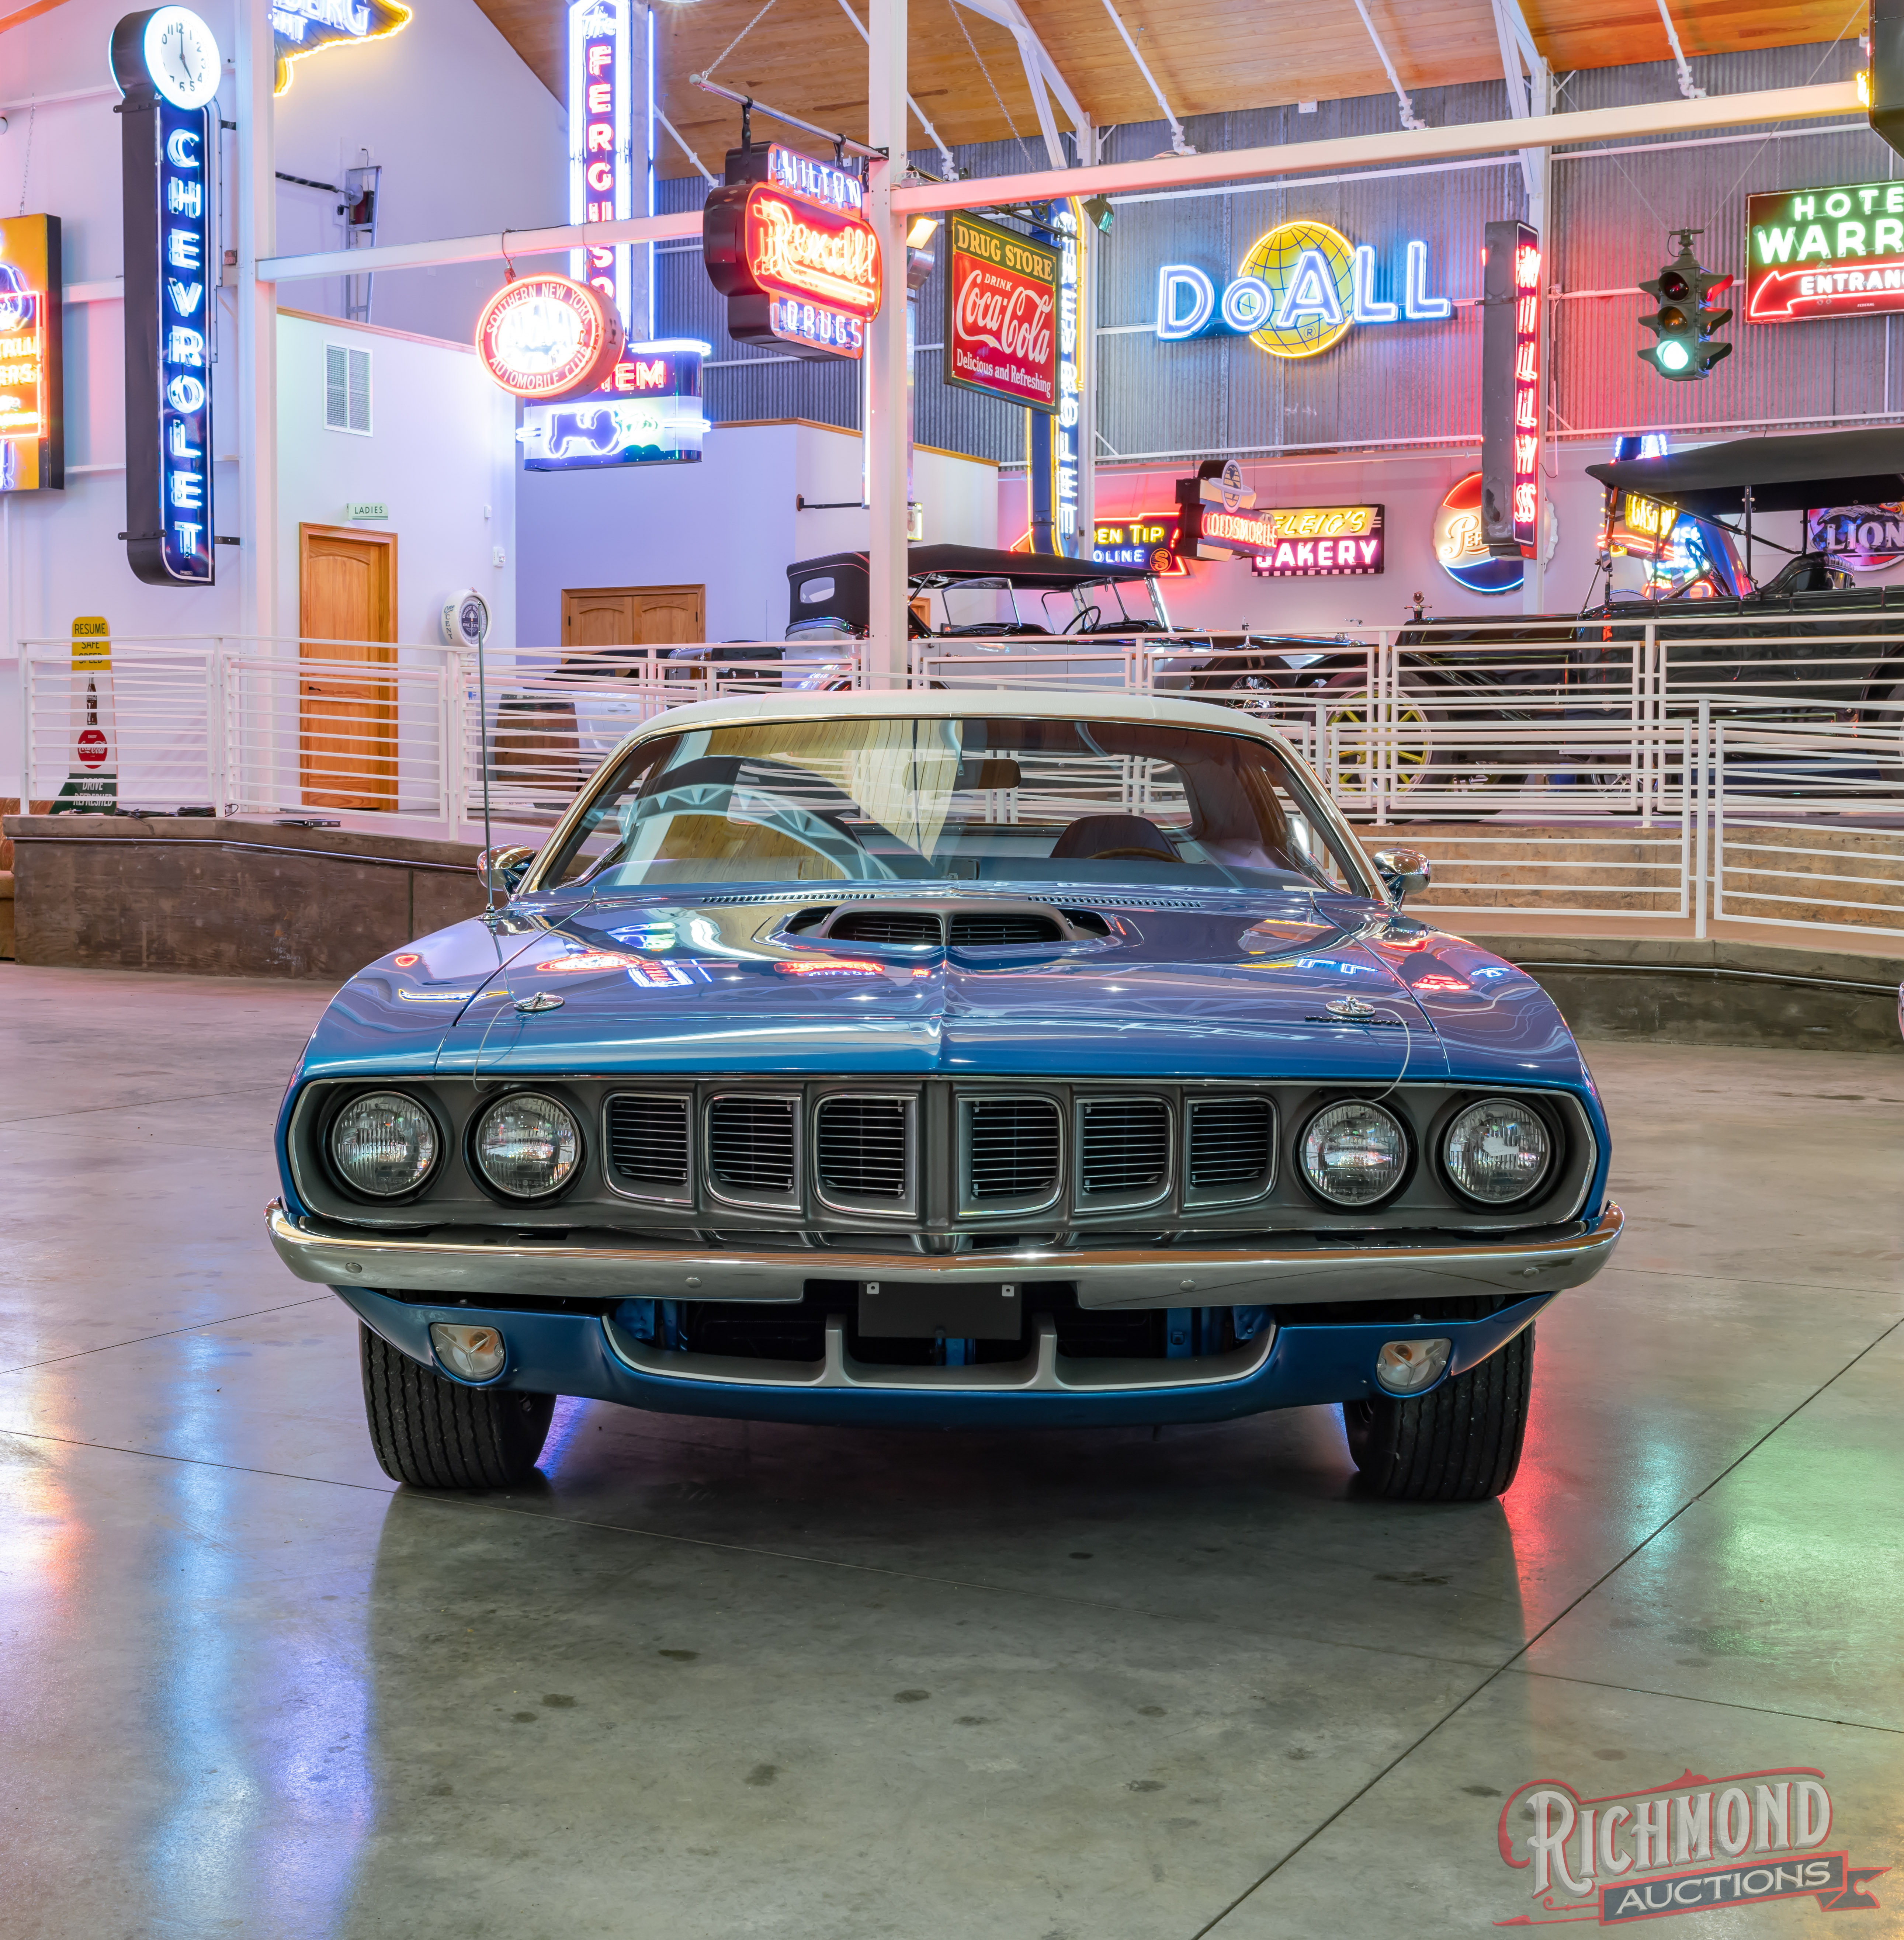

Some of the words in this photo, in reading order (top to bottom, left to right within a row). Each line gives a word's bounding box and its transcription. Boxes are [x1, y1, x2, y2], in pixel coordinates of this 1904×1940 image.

[189, 80, 195, 92] 5
[776, 150, 862, 208] WILTON
[1793, 187, 1904, 221] HOTE
[753, 197, 877, 303] Rexall
[957, 225, 1001, 261] DRUG
[1006, 244, 1053, 281] STORE
[1758, 219, 1904, 264] WARR
[984, 273, 1013, 292] DRINK
[1157, 240, 1452, 339] DoALL
[1801, 269, 1904, 295] ENTRAN
[486, 284, 536, 333] SOUTHERN
[542, 283, 567, 299] NEW
[569, 289, 593, 324] YORK
[778, 297, 863, 347] DRUGS
[956, 270, 1053, 364] Coca-Cola
[167, 128, 205, 558] CHEVROLET
[489, 357, 559, 390] AUTOMOBILE
[957, 348, 993, 376] Delicious
[995, 364, 1009, 381] and
[1011, 365, 1051, 399] Refreshing
[1515, 247, 1541, 523] WILLYS
[355, 506, 383, 514] LADIES
[1202, 512, 1278, 549] OLDSMOBILE
[1093, 549, 1145, 563] OLINE
[74, 623, 106, 634] RESUME
[462, 606, 472, 618] HONEST
[81, 641, 100, 649] SAFE
[79, 740, 106, 754] Coca-Cola
[73, 793, 113, 806] REFRESHED
[82, 777, 103, 791] DRIVE
